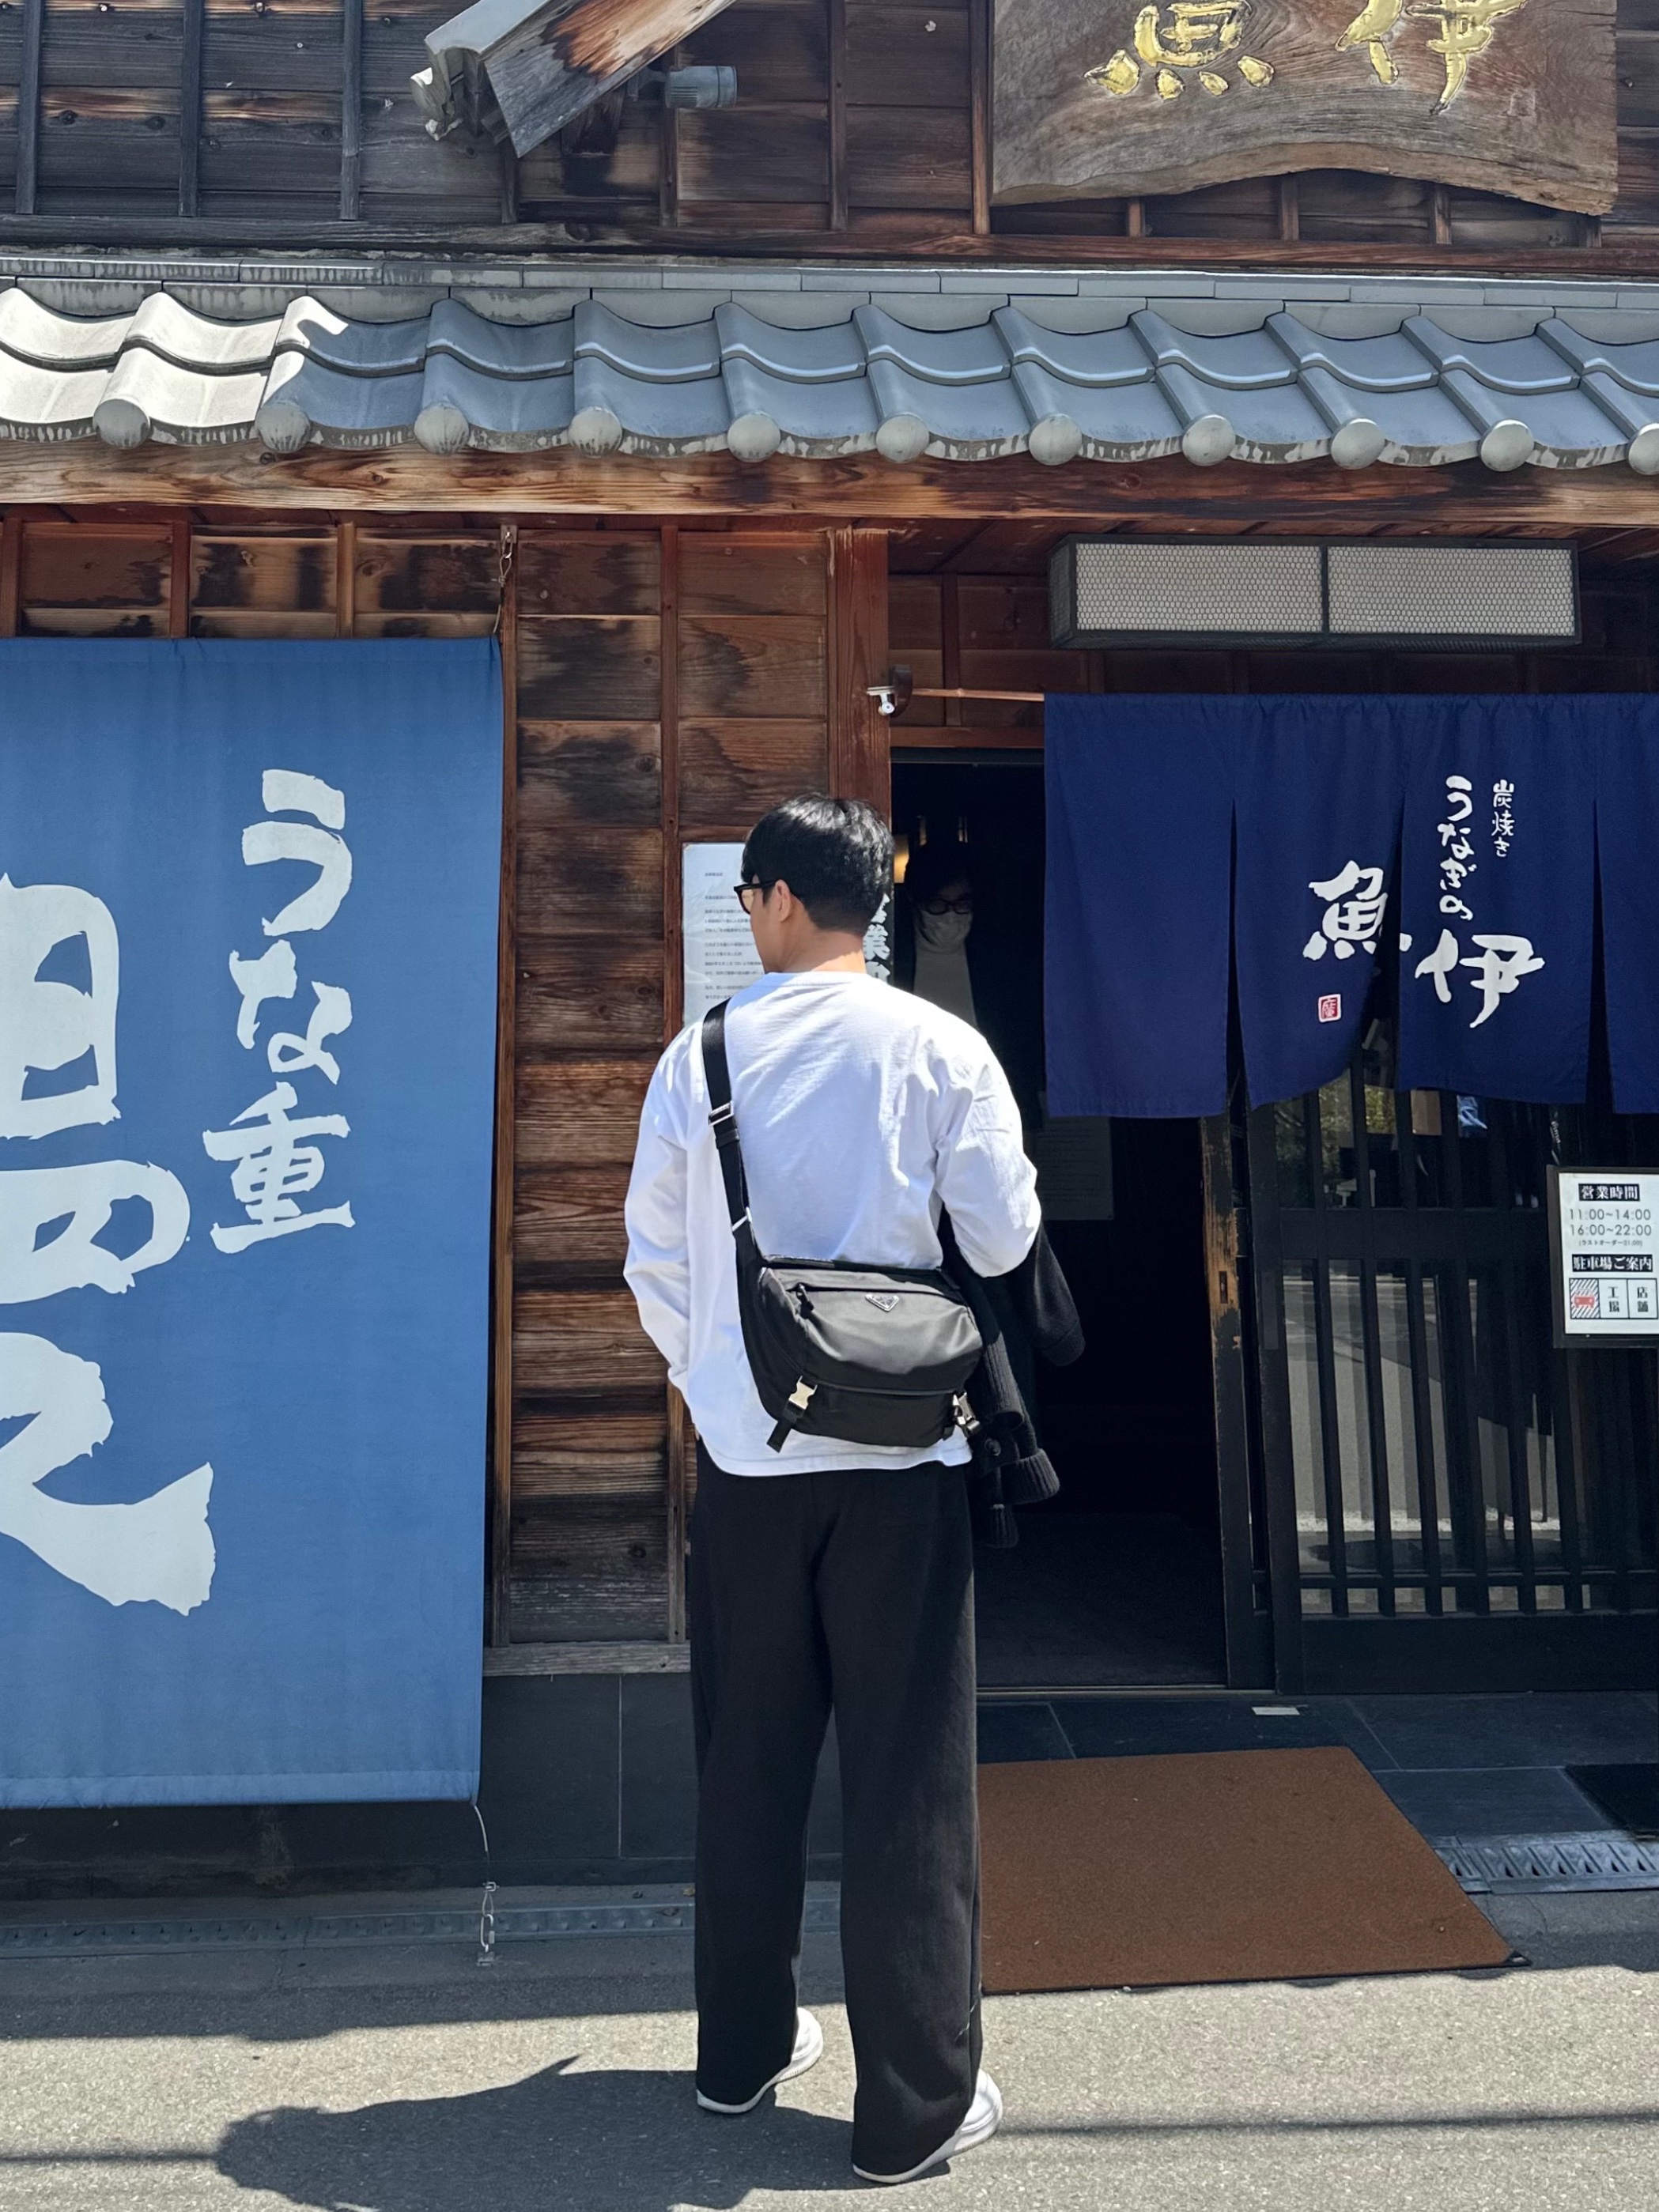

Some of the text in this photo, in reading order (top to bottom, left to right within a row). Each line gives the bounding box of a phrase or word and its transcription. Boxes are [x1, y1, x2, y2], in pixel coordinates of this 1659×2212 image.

[1437, 775, 1477, 921] うなぎの
[1491, 779, 1515, 858] 炭焼き
[1302, 859, 1546, 1029] 魚伊
[202, 768, 356, 1254] うな重
[1581, 1185, 1638, 1200] 営業時間
[1573, 1255, 1653, 1271] 駐車場ご案内
